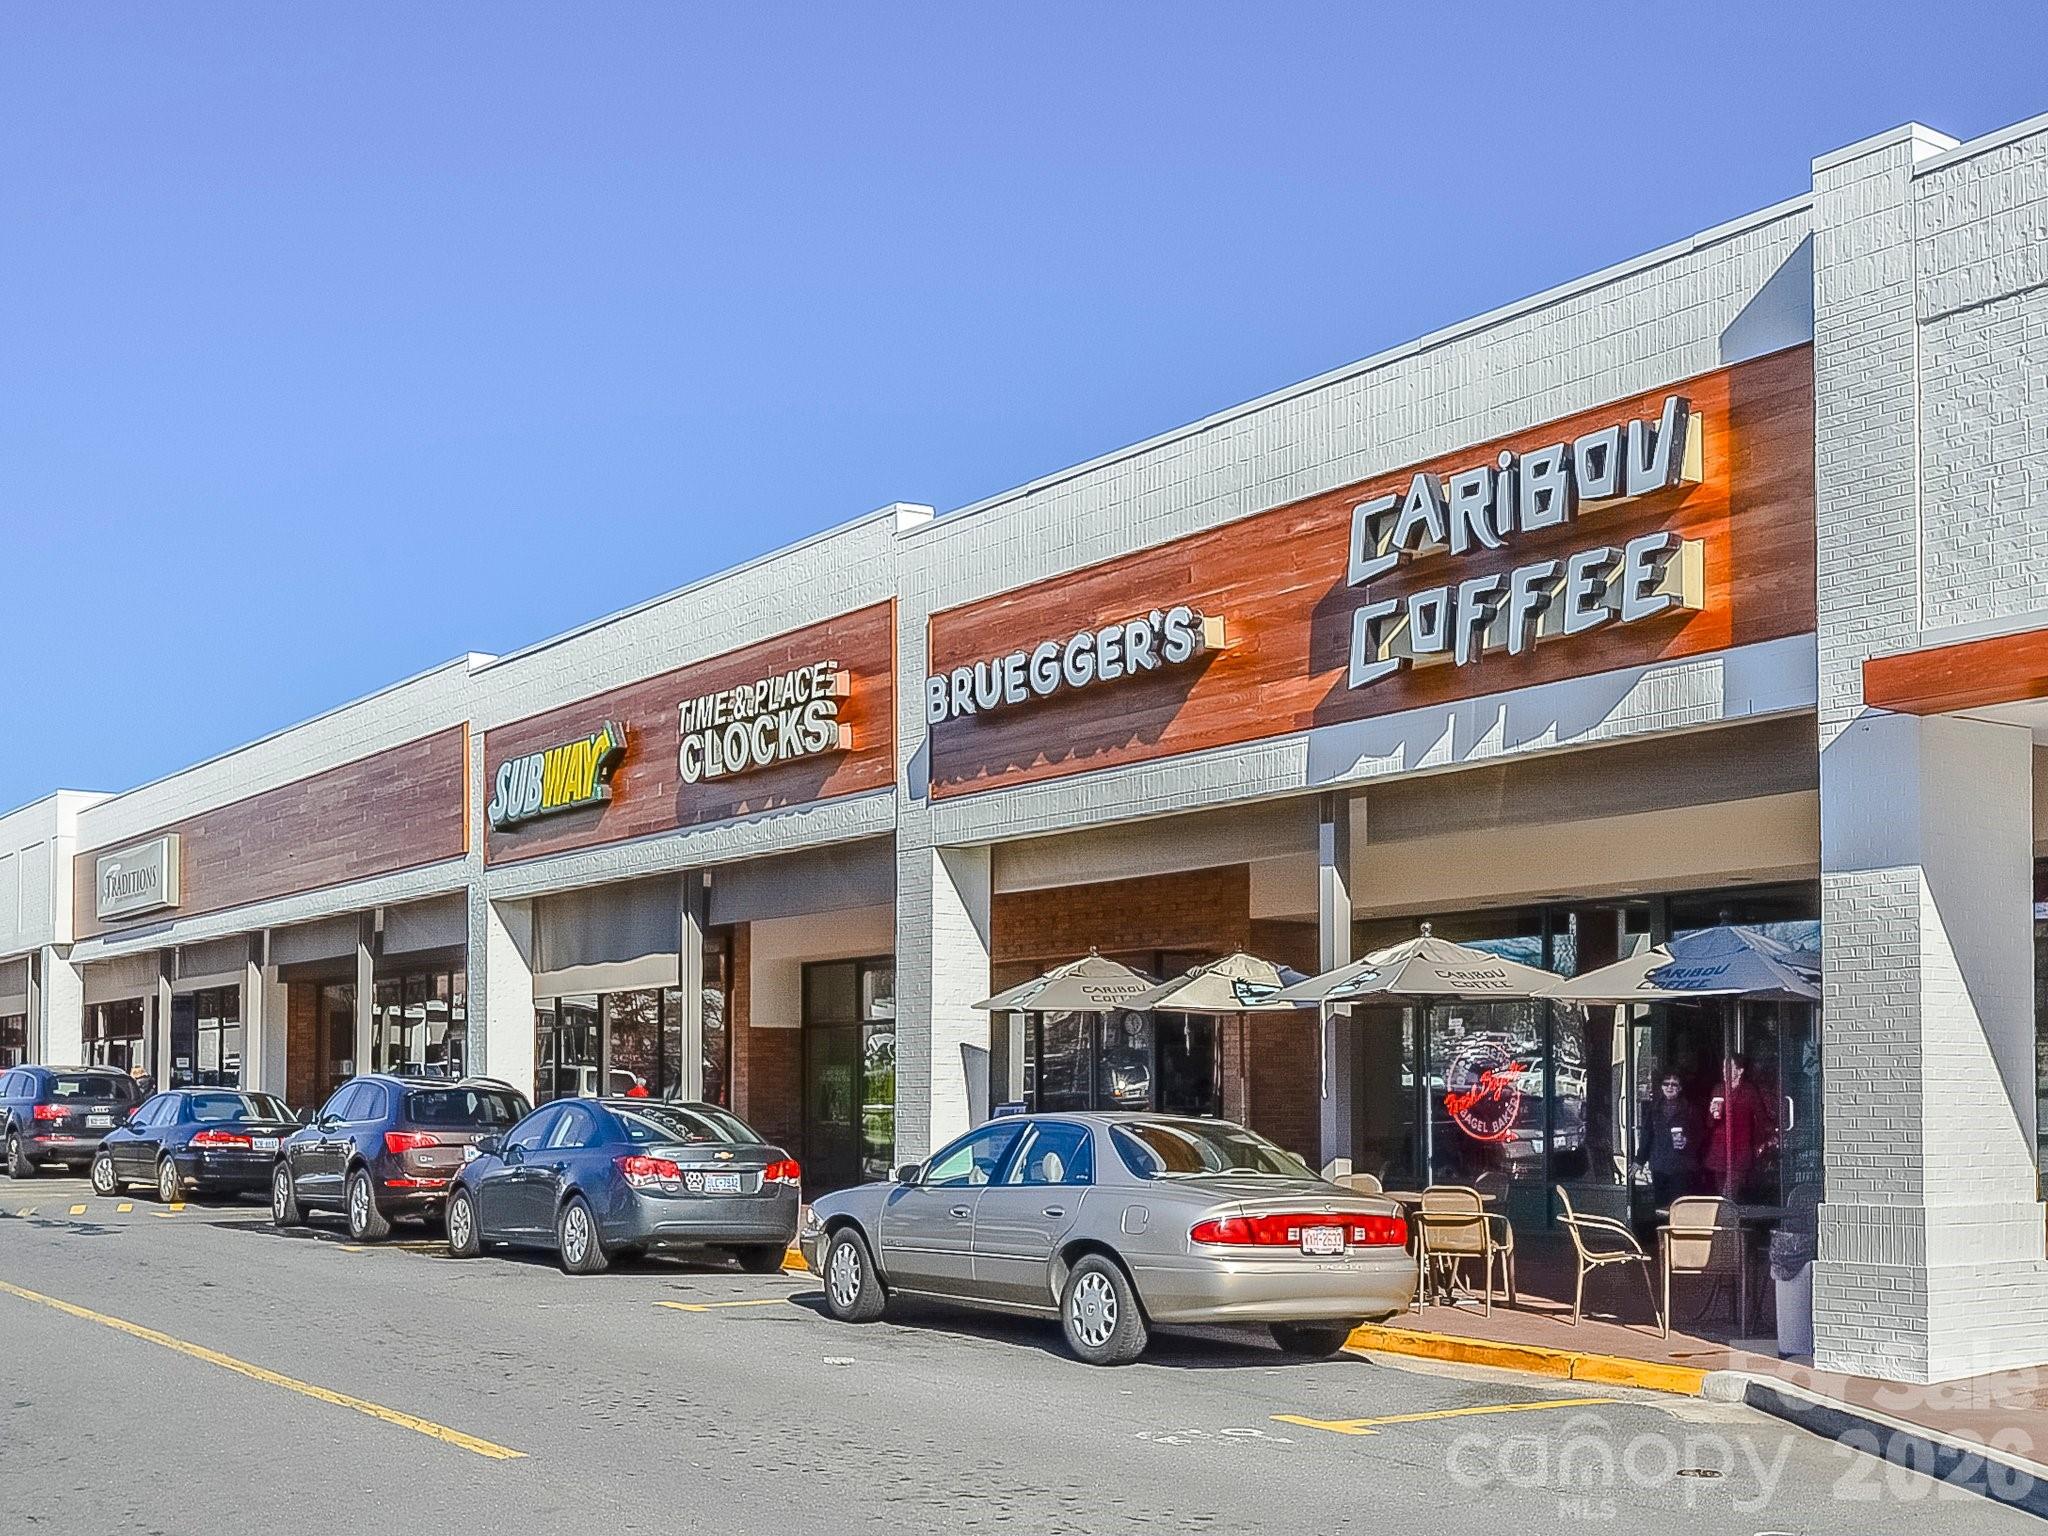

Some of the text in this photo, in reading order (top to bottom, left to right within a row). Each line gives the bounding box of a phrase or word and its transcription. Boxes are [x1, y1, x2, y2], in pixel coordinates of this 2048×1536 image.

[1348, 532, 1674, 690] COFFEE
[926, 605, 1196, 725] BRUEGGER'S
[678, 690, 731, 735] TIME
[754, 661, 834, 714] PLACE
[679, 700, 833, 784] CLOCKS
[487, 726, 612, 824] SUBWAY
[105, 865, 158, 900] TRADITIONS
[1082, 983, 1147, 994] CARIBOU
[1090, 994, 1133, 1004] COFF
[1434, 967, 1507, 980] CARIBOU
[1459, 1107, 1488, 1134] BAGEL
